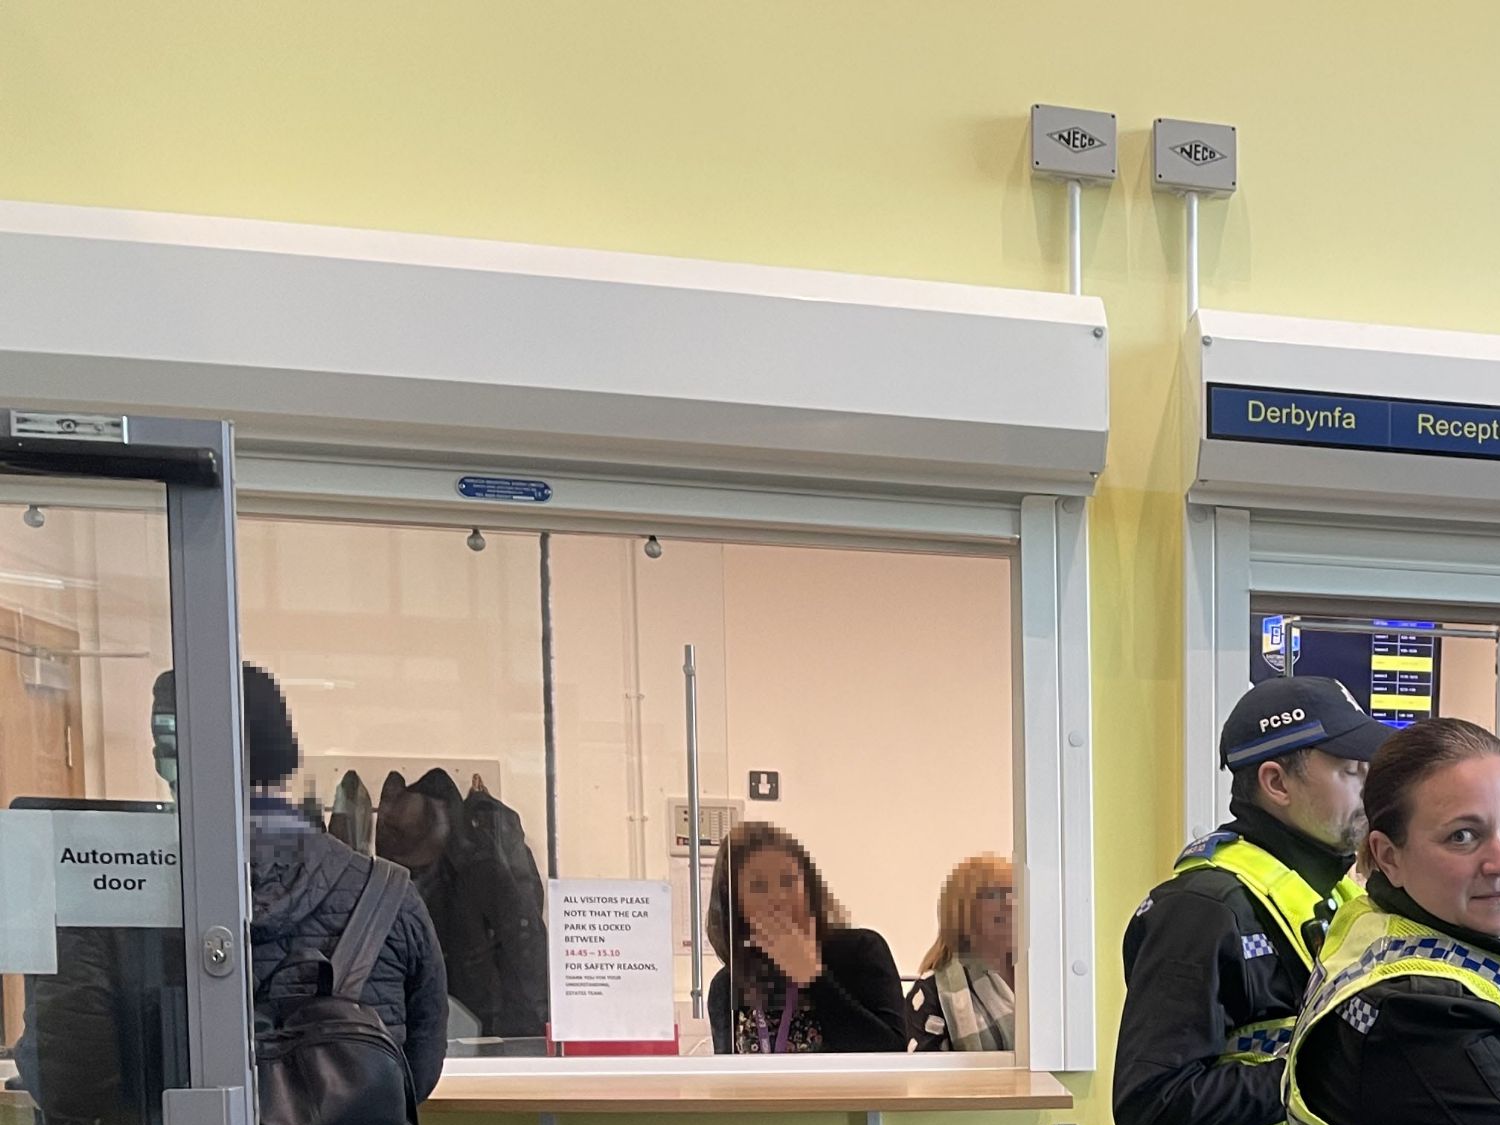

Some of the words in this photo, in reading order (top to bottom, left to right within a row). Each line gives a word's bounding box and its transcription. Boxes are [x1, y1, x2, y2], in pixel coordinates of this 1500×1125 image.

[1058, 131, 1094, 148] NECO
[1180, 144, 1216, 161] NECO
[1248, 400, 1356, 432] Derbynfa
[1260, 708, 1305, 732] PCSO
[60, 848, 177, 866] Automatic
[93, 874, 146, 890] door
